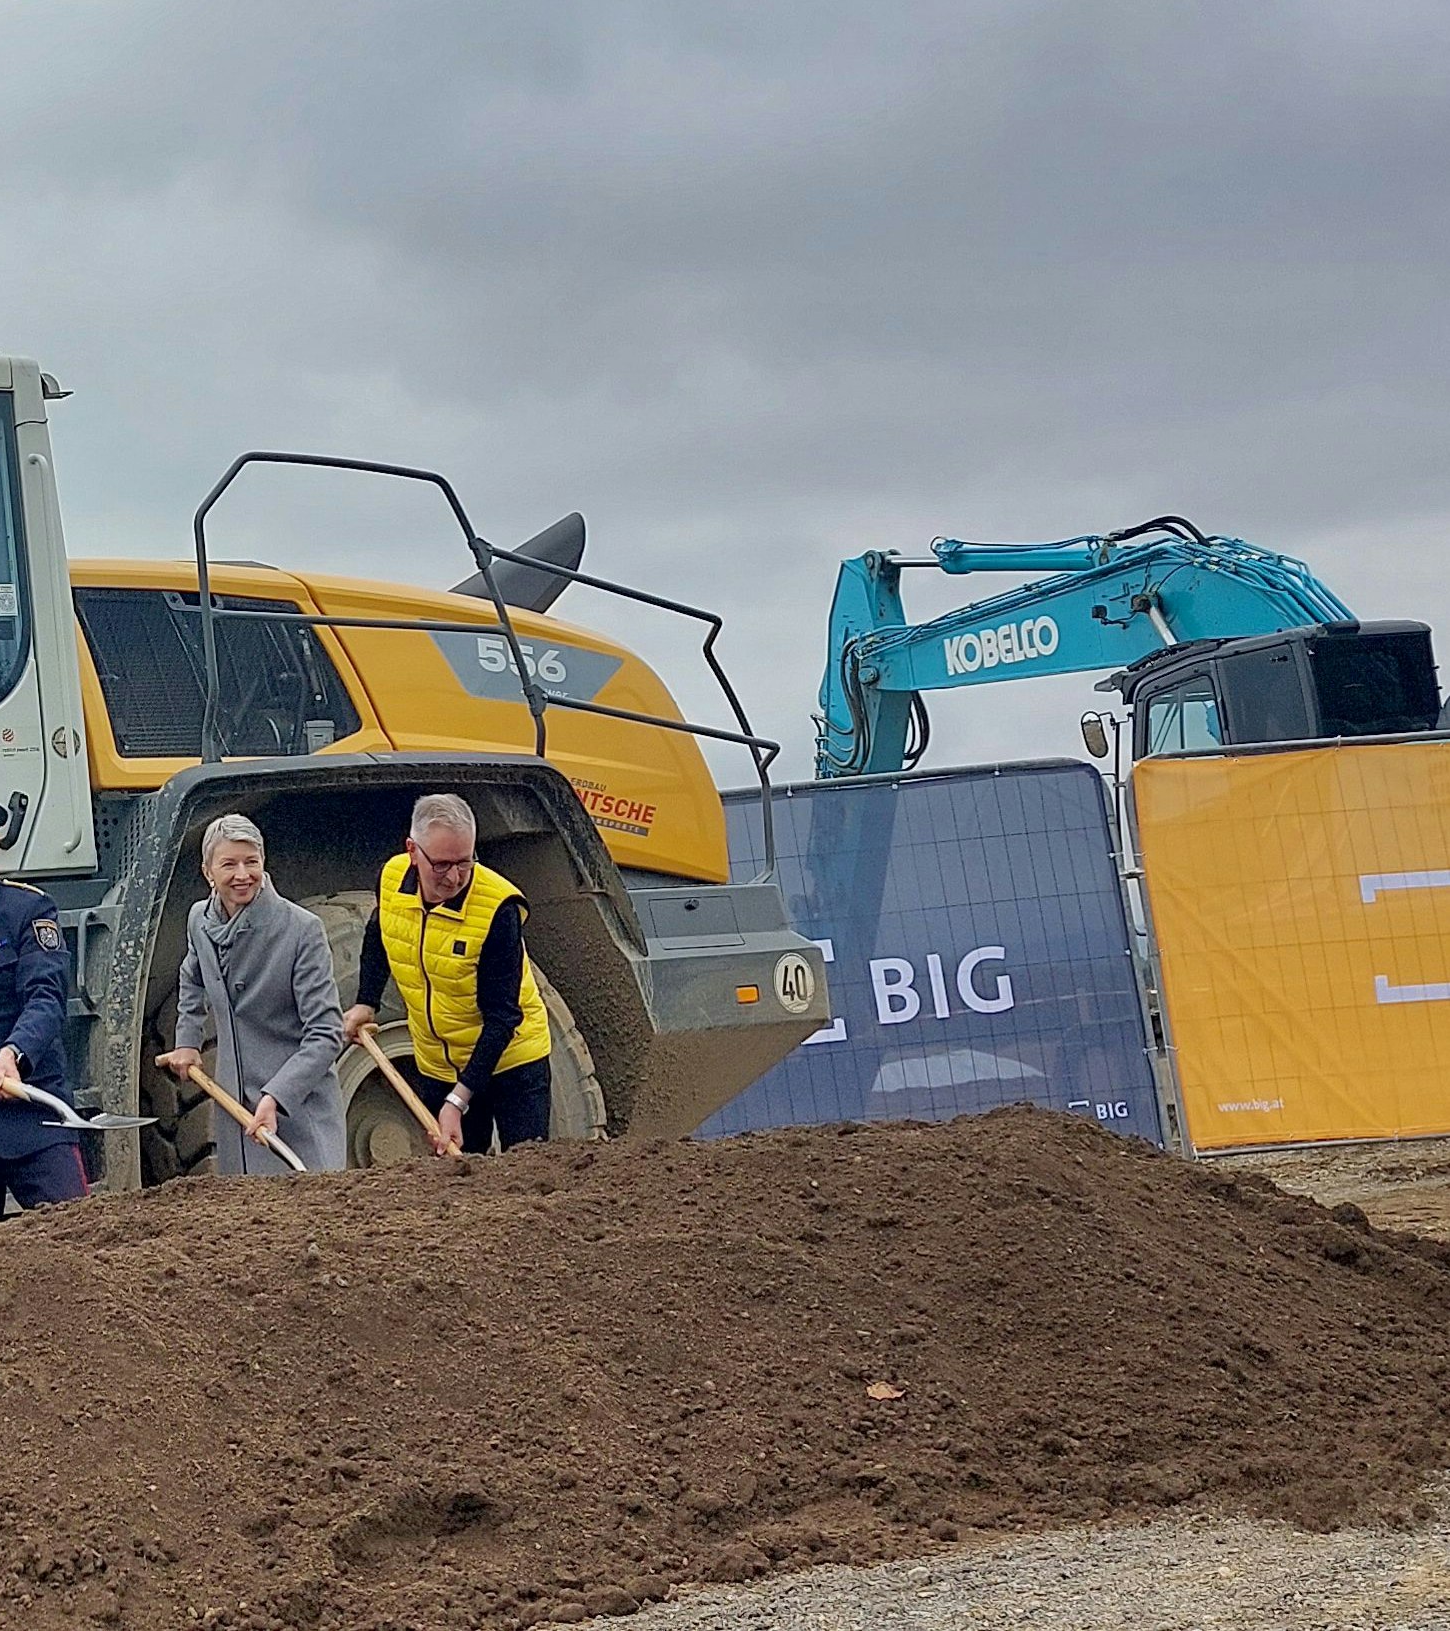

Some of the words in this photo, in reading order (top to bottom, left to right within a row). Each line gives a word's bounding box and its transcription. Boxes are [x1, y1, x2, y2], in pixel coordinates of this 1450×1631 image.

[477, 637, 567, 683] 556
[943, 615, 1060, 677] KOBELCO
[782, 964, 807, 1001] 40
[869, 945, 1015, 1025] BIG
[1095, 1101, 1129, 1120] BIG
[1217, 1097, 1286, 1113] www.big.at
